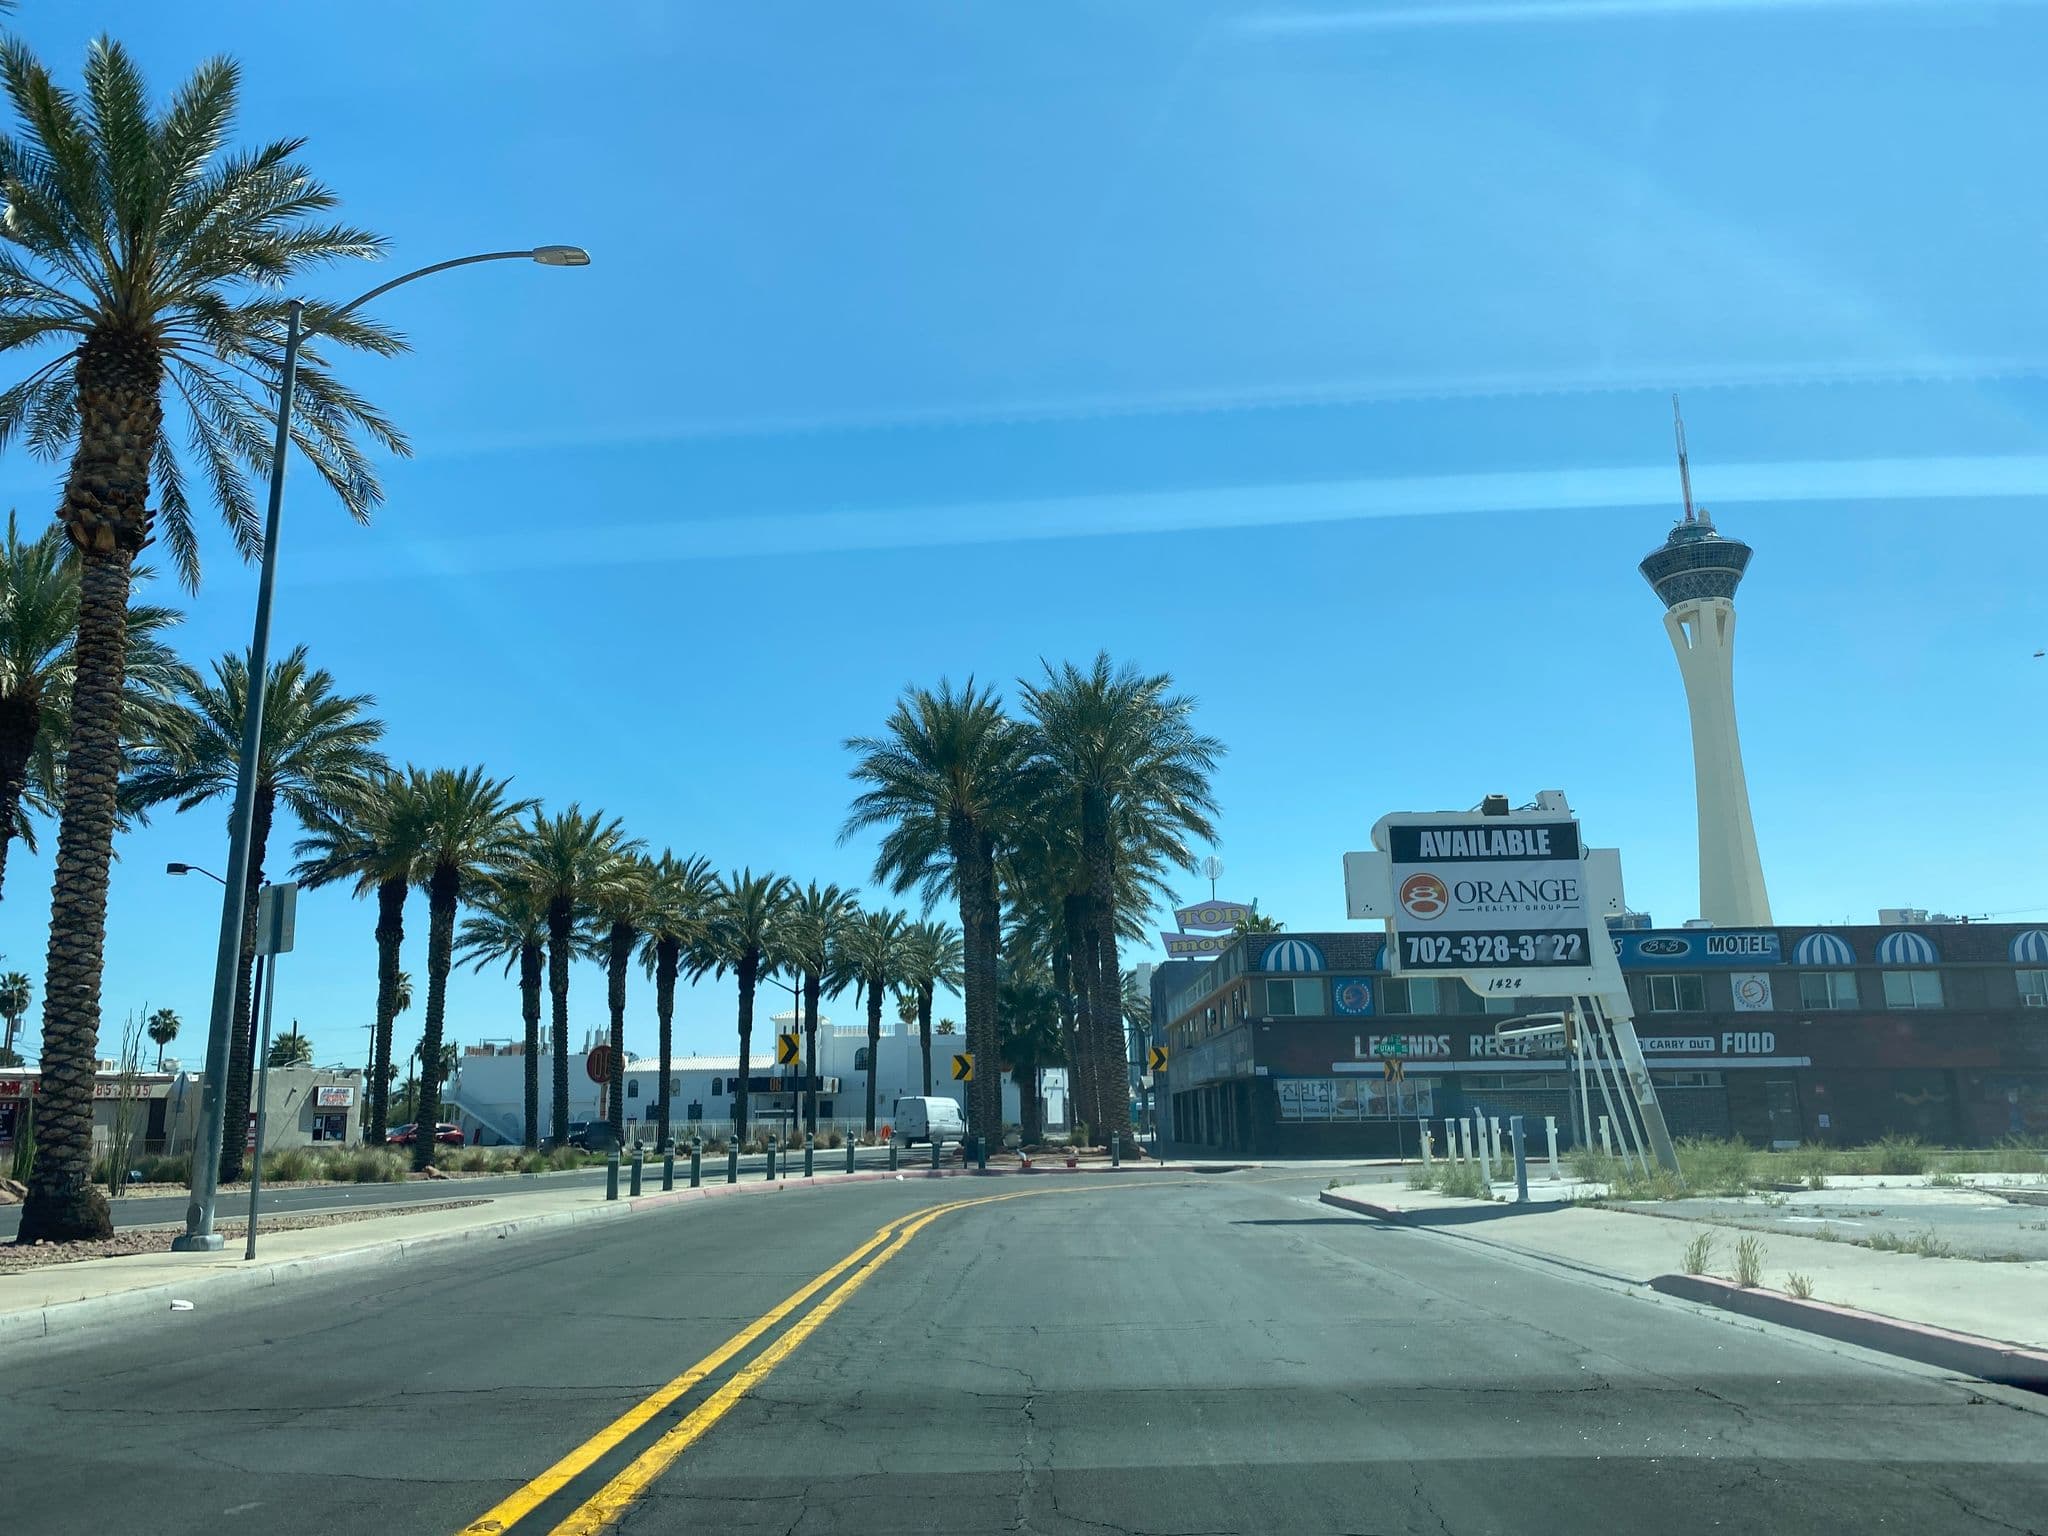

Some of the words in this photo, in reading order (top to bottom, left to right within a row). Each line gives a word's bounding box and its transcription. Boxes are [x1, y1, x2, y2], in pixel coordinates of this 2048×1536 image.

[1420, 829, 1552, 857] AVAILABLE
[1454, 879, 1579, 904] ORANGE
[1178, 908, 1247, 925] TOD
[1477, 904, 1518, 912] REALTY
[1525, 903, 1562, 911] GROUP
[1707, 935, 1772, 955] MOTEL
[1488, 978, 1522, 991] 1424
[1649, 1039, 1684, 1049] CARRY
[1689, 1039, 1711, 1049] OUT
[1721, 1032, 1775, 1054] FOOD
